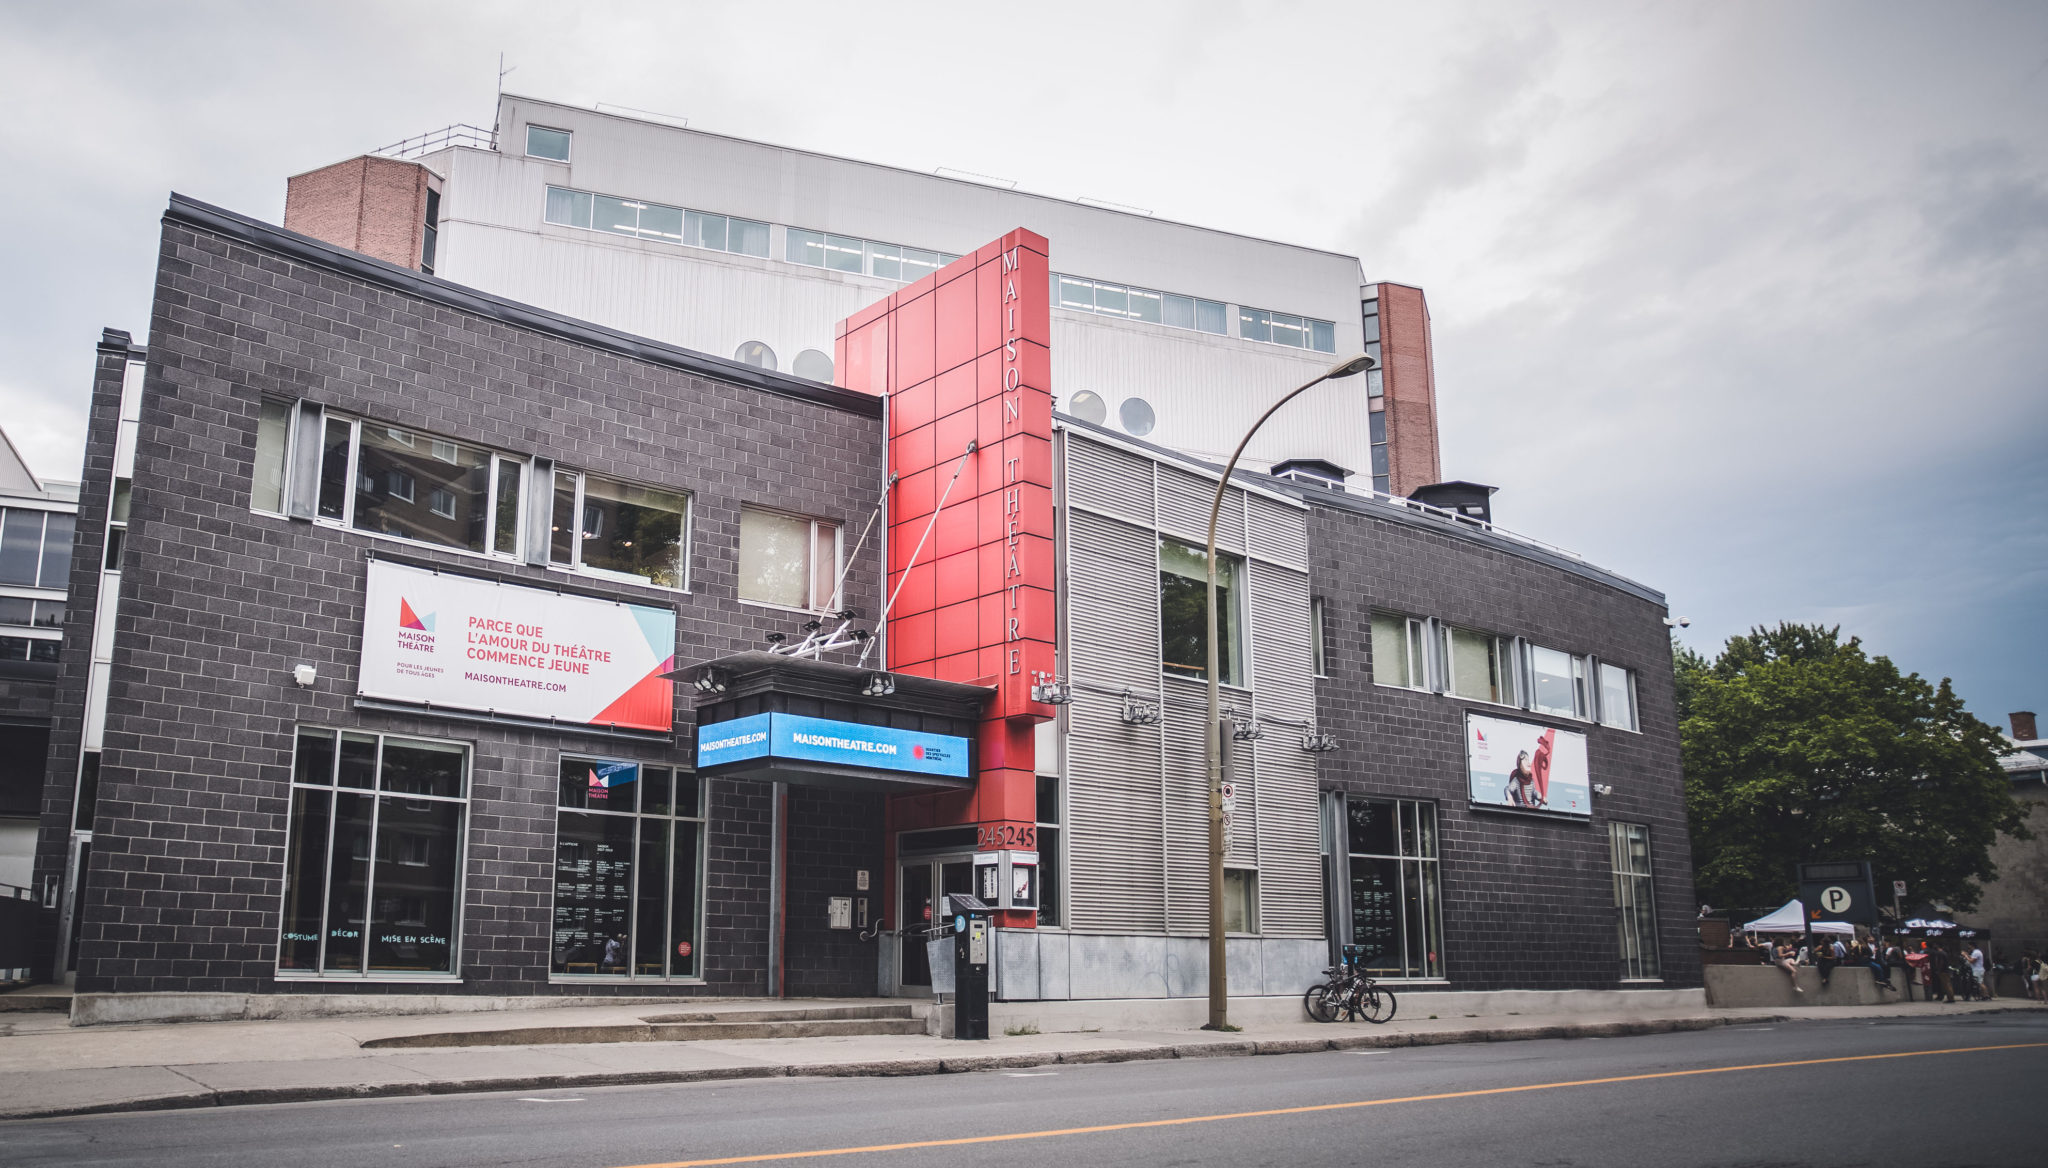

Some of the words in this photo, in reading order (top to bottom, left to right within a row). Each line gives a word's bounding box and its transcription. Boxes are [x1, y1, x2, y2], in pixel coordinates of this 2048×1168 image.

[1003, 247, 1019, 424] MAISON
[1007, 458, 1020, 675] THÉÂTRE
[398, 631, 435, 643] MAISON
[468, 616, 512, 633] PARCE
[516, 624, 543, 638] QUE
[398, 641, 435, 653] THÉÂTRE
[467, 632, 528, 651] L'AMOUR
[532, 641, 550, 654] DU
[554, 644, 611, 663] THÉÂTRE
[467, 647, 545, 669] COMMENCE
[548, 659, 589, 675] JEUNE
[464, 672, 567, 692] MAISONTHEATRE.COM
[700, 731, 767, 753] MAISONTHEATRE.COM
[793, 732, 897, 755] MAISONTHEATRE.COM
[978, 826, 1005, 847] 245
[1006, 826, 1034, 847] 245
[1829, 889, 1843, 910] P
[282, 932, 319, 941] COSTUME
[331, 928, 359, 938] DÉCOR
[381, 935, 402, 943] MISE
[404, 935, 416, 943] EN
[420, 933, 446, 945] SCÈNE
